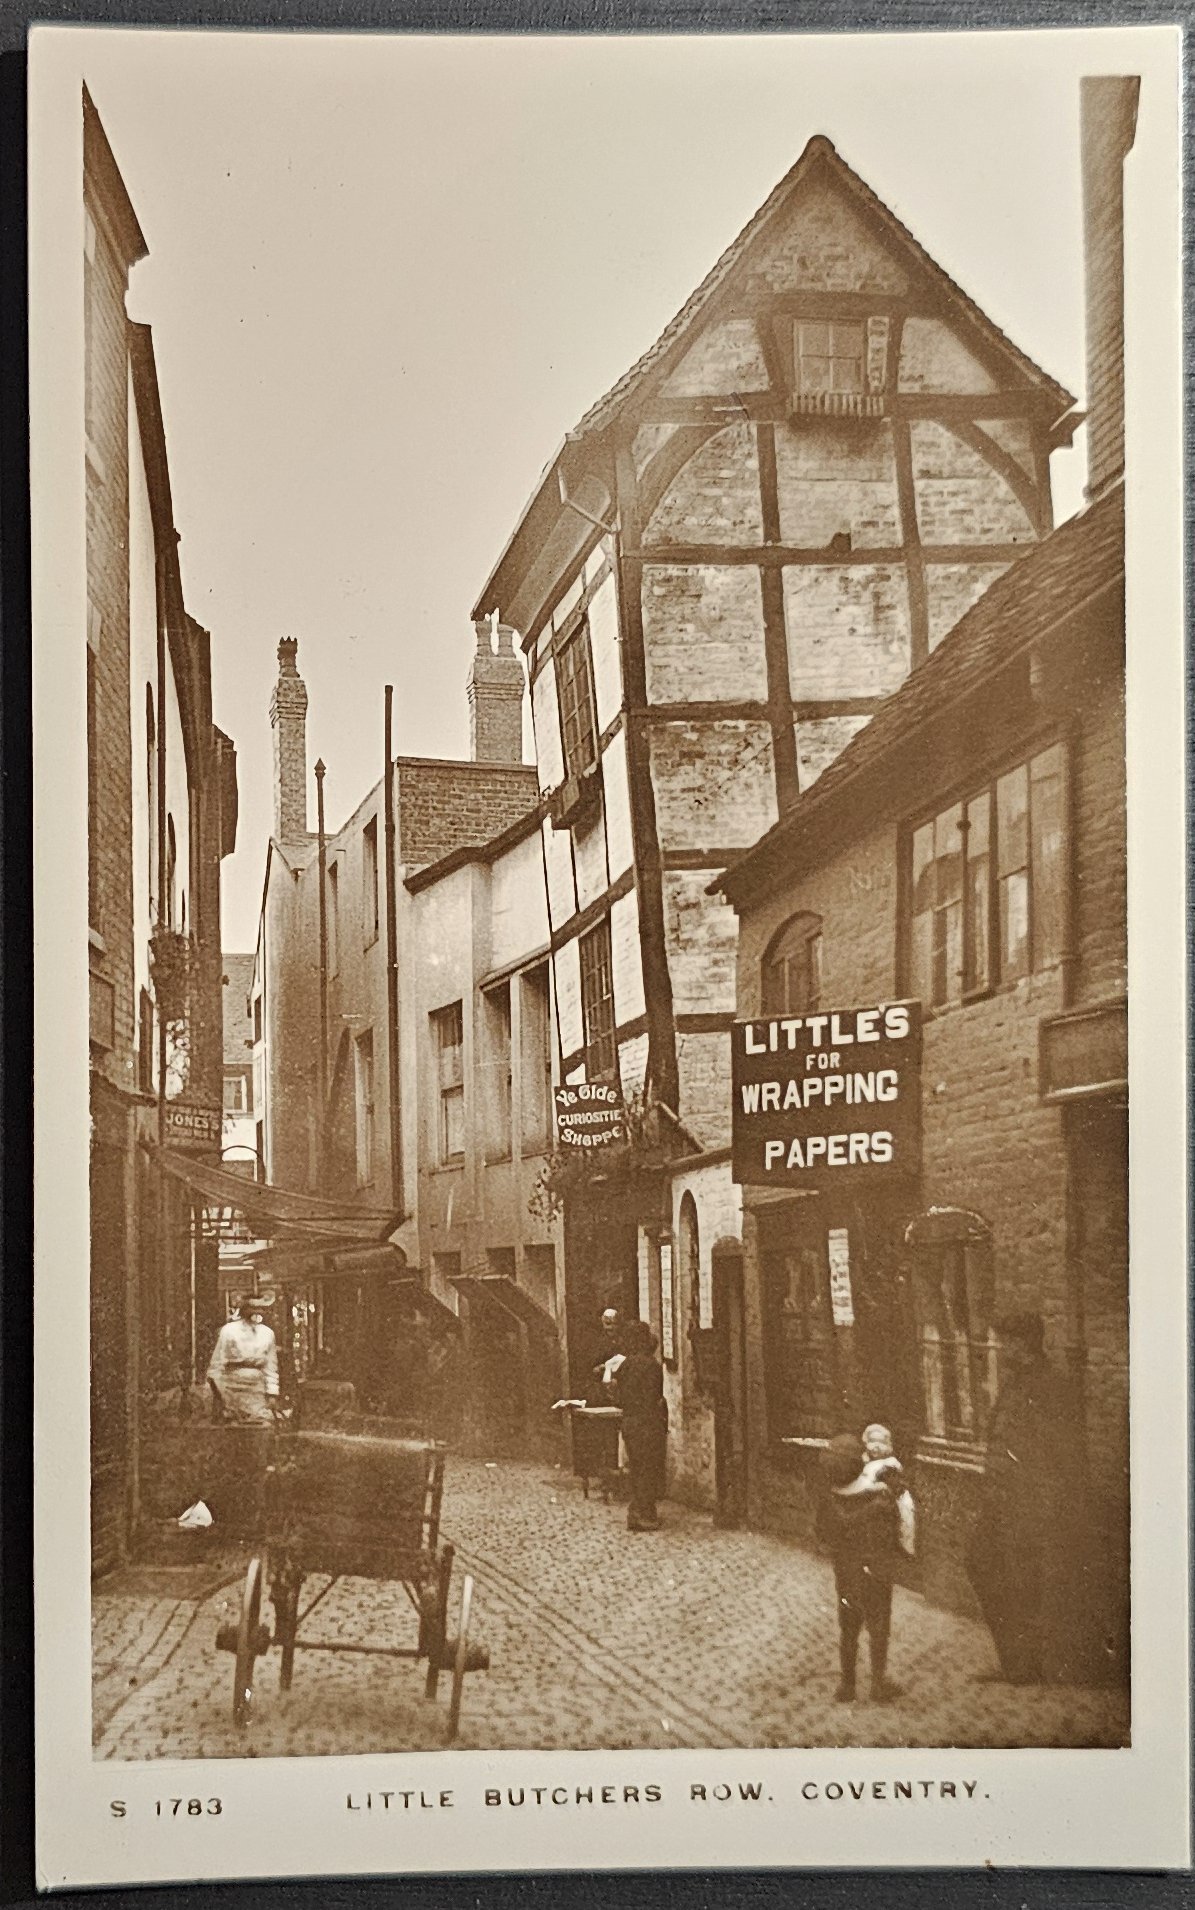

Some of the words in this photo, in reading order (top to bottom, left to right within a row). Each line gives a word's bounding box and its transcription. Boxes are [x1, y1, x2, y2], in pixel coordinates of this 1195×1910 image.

[745, 1004, 909, 1055] LITTLE'S
[806, 1051, 841, 1071] FOR
[556, 1090, 578, 1107] Ye
[578, 1084, 618, 1104] Olde
[741, 1069, 898, 1114] WRAPPING
[557, 1109, 622, 1127] CURIOSITIE
[765, 1131, 893, 1171] PAPERS
[109, 1800, 127, 1818] S
[155, 1797, 224, 1817] 1783
[346, 1790, 454, 1810] LITTLE
[484, 1784, 662, 1807] BUTCHERS
[690, 1782, 774, 1802] ROW.
[801, 1780, 990, 1801] COVENTRY.
